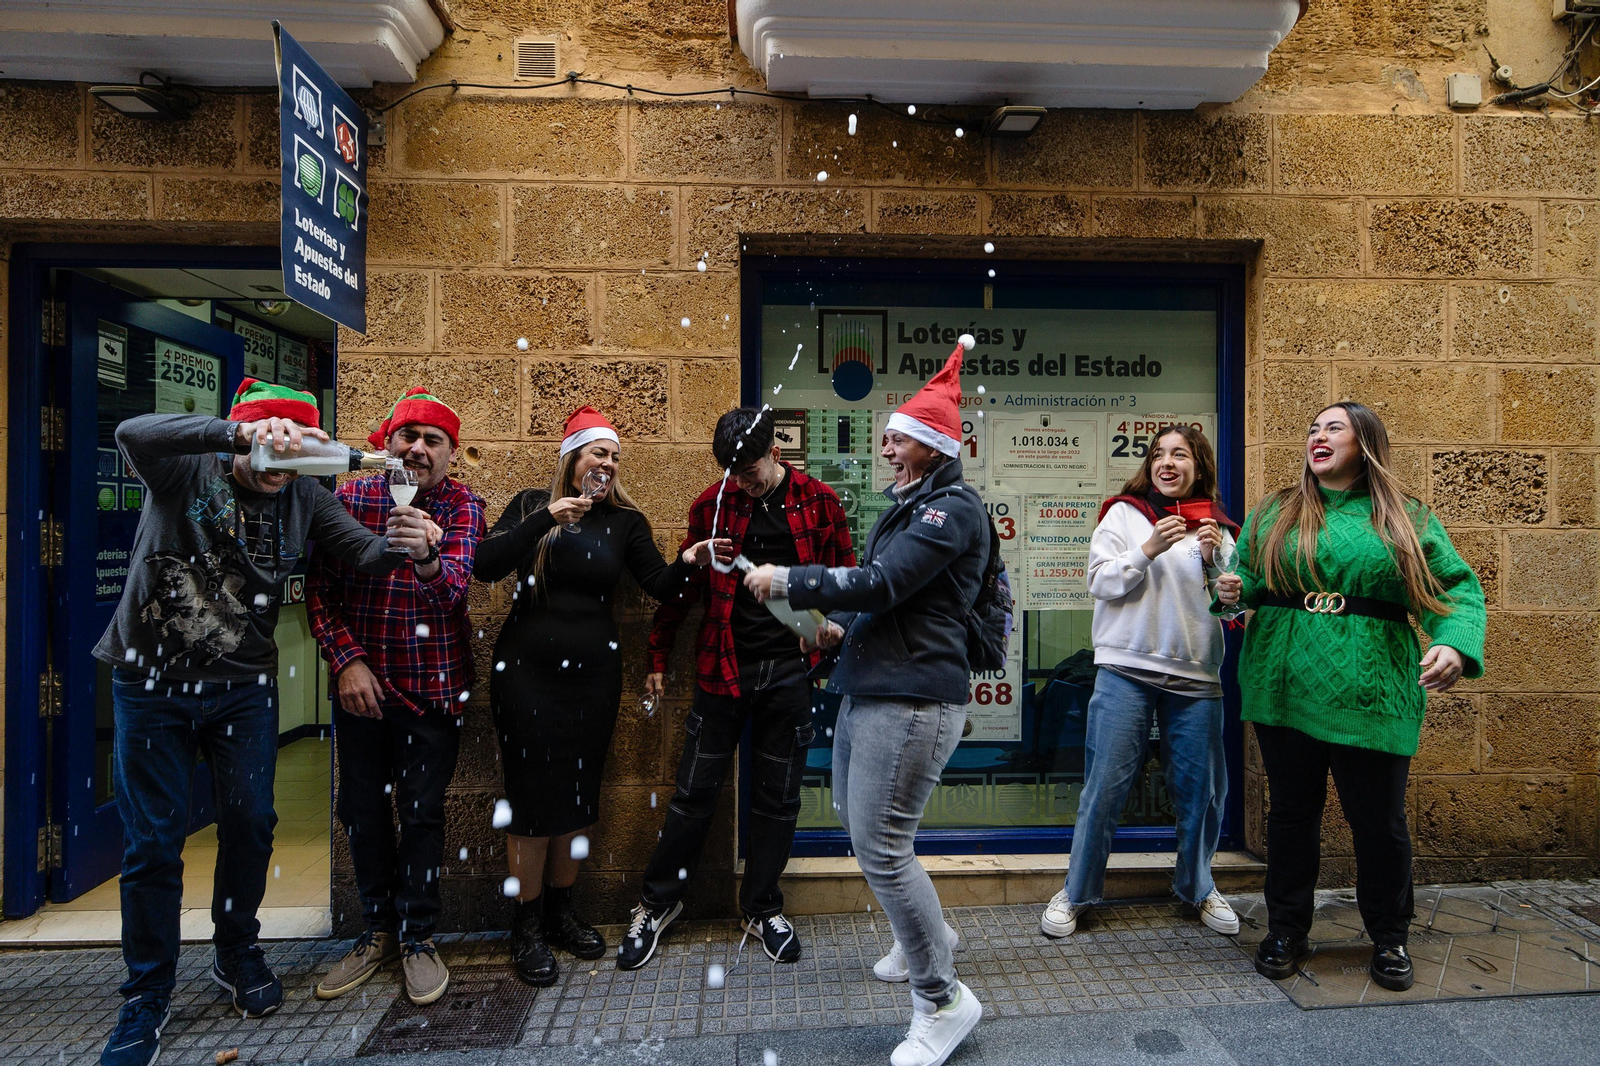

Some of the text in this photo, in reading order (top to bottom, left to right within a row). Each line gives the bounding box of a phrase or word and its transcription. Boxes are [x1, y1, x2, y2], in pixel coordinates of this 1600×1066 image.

[339, 242, 346, 261] y
[294, 236, 358, 290] Apuestas del
[294, 264, 331, 300] Estado
[245, 328, 273, 345] PREMIO
[897, 322, 1027, 351] Loterías y
[244, 338, 274, 360] 5296
[174, 351, 214, 372] PREMIO
[1028, 353, 1067, 377] del
[1075, 354, 1163, 378] Estado
[161, 360, 217, 392] 25296
[886, 393, 898, 405] El
[960, 395, 983, 408] gro
[1004, 394, 1106, 407] Administración
[1129, 395, 1137, 407] 3
[1011, 436, 1080, 447] 1.018.034 €
[1111, 435, 1149, 459] 25
[1039, 508, 1079, 518] 10.000
[1072, 536, 1091, 544] AQU
[96, 548, 128, 560] oterías
[96, 566, 130, 580] puesta
[1033, 568, 1084, 578] 11.259.70
[1069, 591, 1089, 600] AQUÍ
[969, 668, 1006, 680] MIO
[968, 682, 1013, 706] 68
